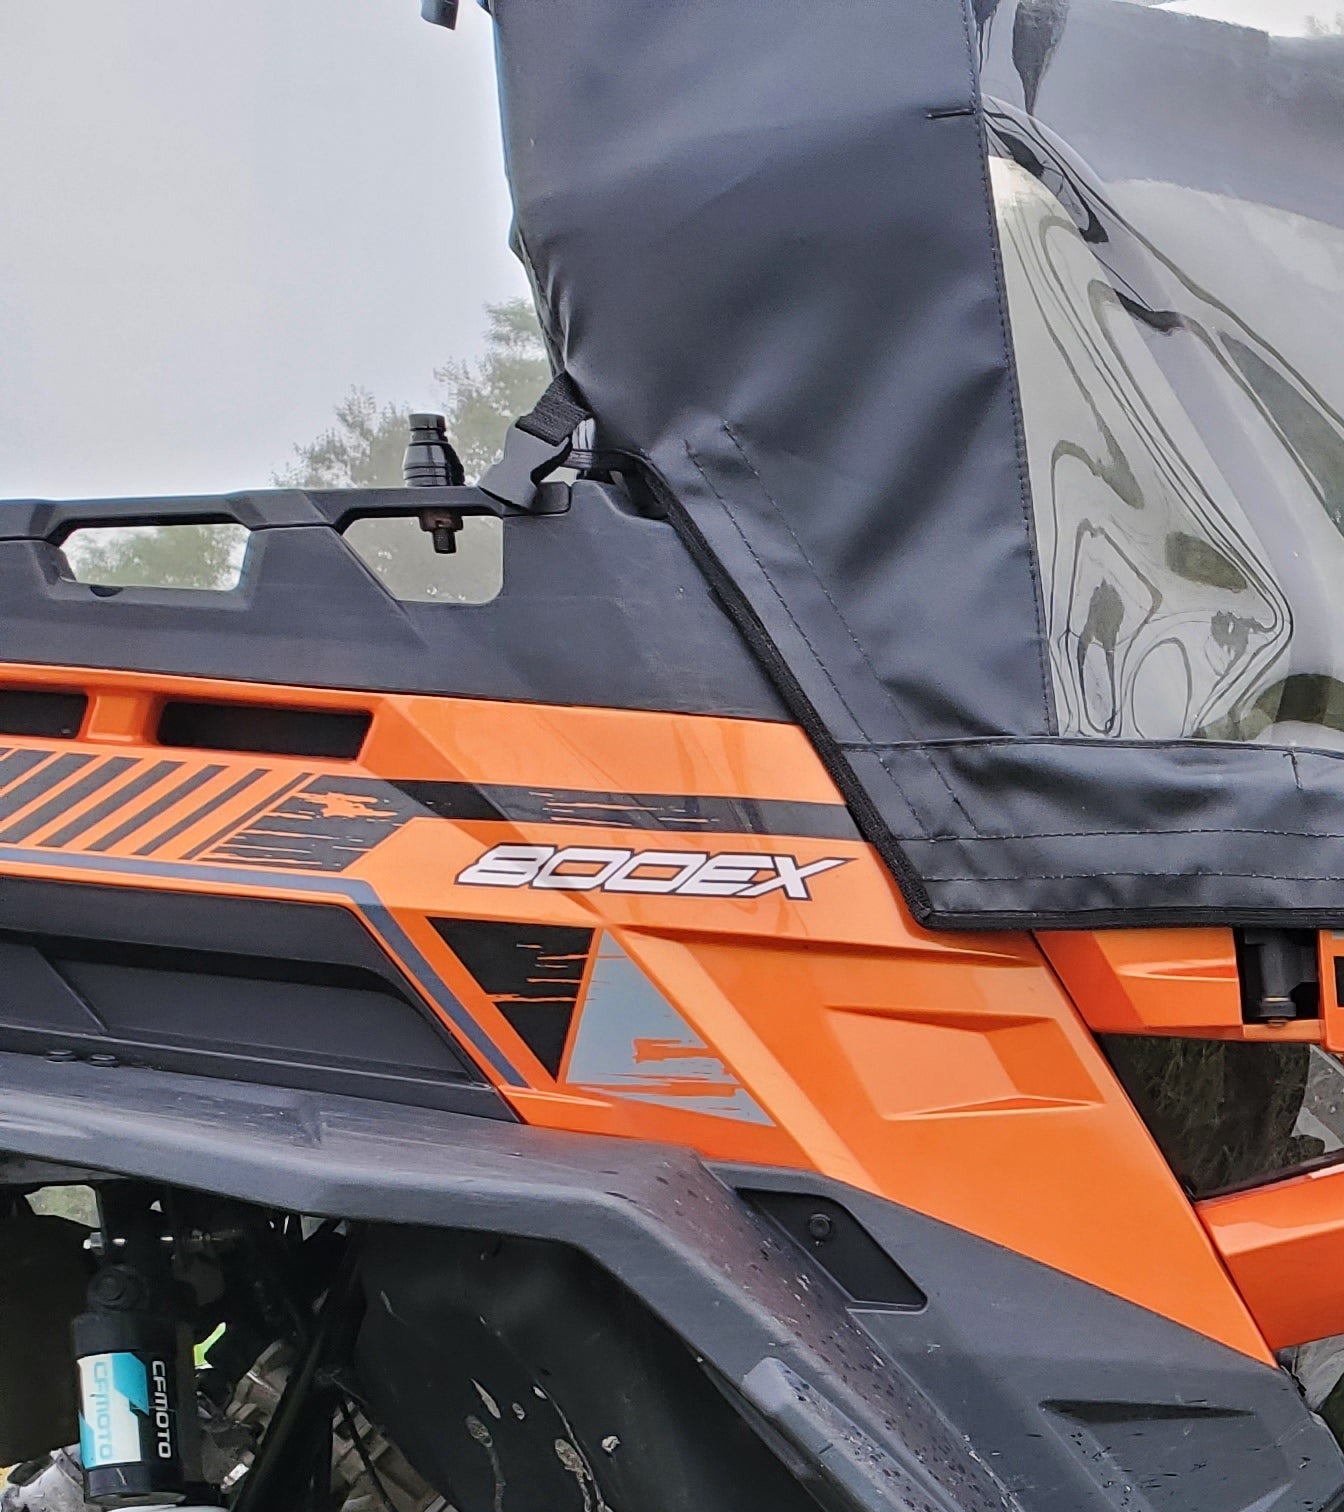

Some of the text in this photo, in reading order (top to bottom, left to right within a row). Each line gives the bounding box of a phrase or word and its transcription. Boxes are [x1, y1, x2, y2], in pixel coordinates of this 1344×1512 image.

[454, 842, 859, 901] 800EX
[93, 1361, 113, 1460] CFMOTO
[152, 1360, 172, 1459] CFMOTO
